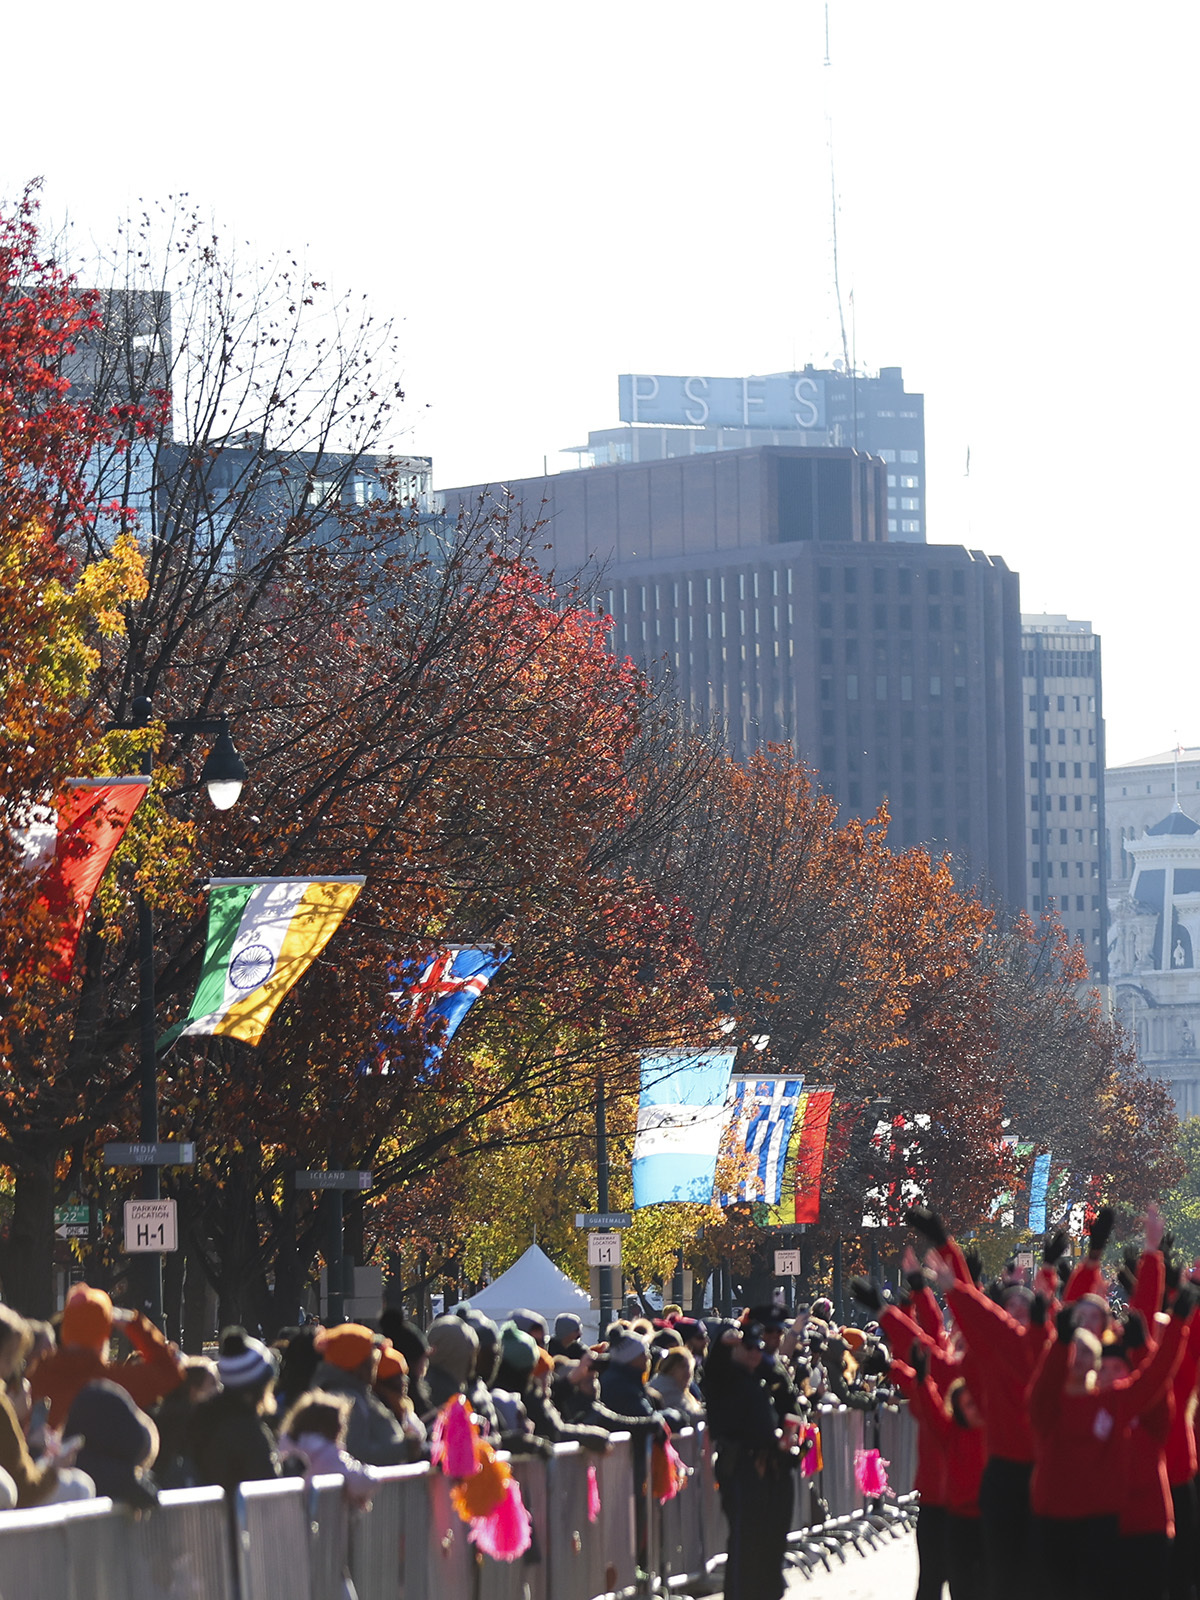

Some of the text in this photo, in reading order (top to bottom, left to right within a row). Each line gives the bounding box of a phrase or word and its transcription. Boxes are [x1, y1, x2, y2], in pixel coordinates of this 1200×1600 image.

[632, 375, 819, 427] PSFS
[129, 1145, 157, 1153] INDIA
[310, 1172, 346, 1180] ICELAND
[132, 1211, 169, 1219] LOCATION
[137, 1223, 164, 1246] H-1
[598, 1247, 611, 1262] I-1
[781, 1261, 793, 1272] J-1
